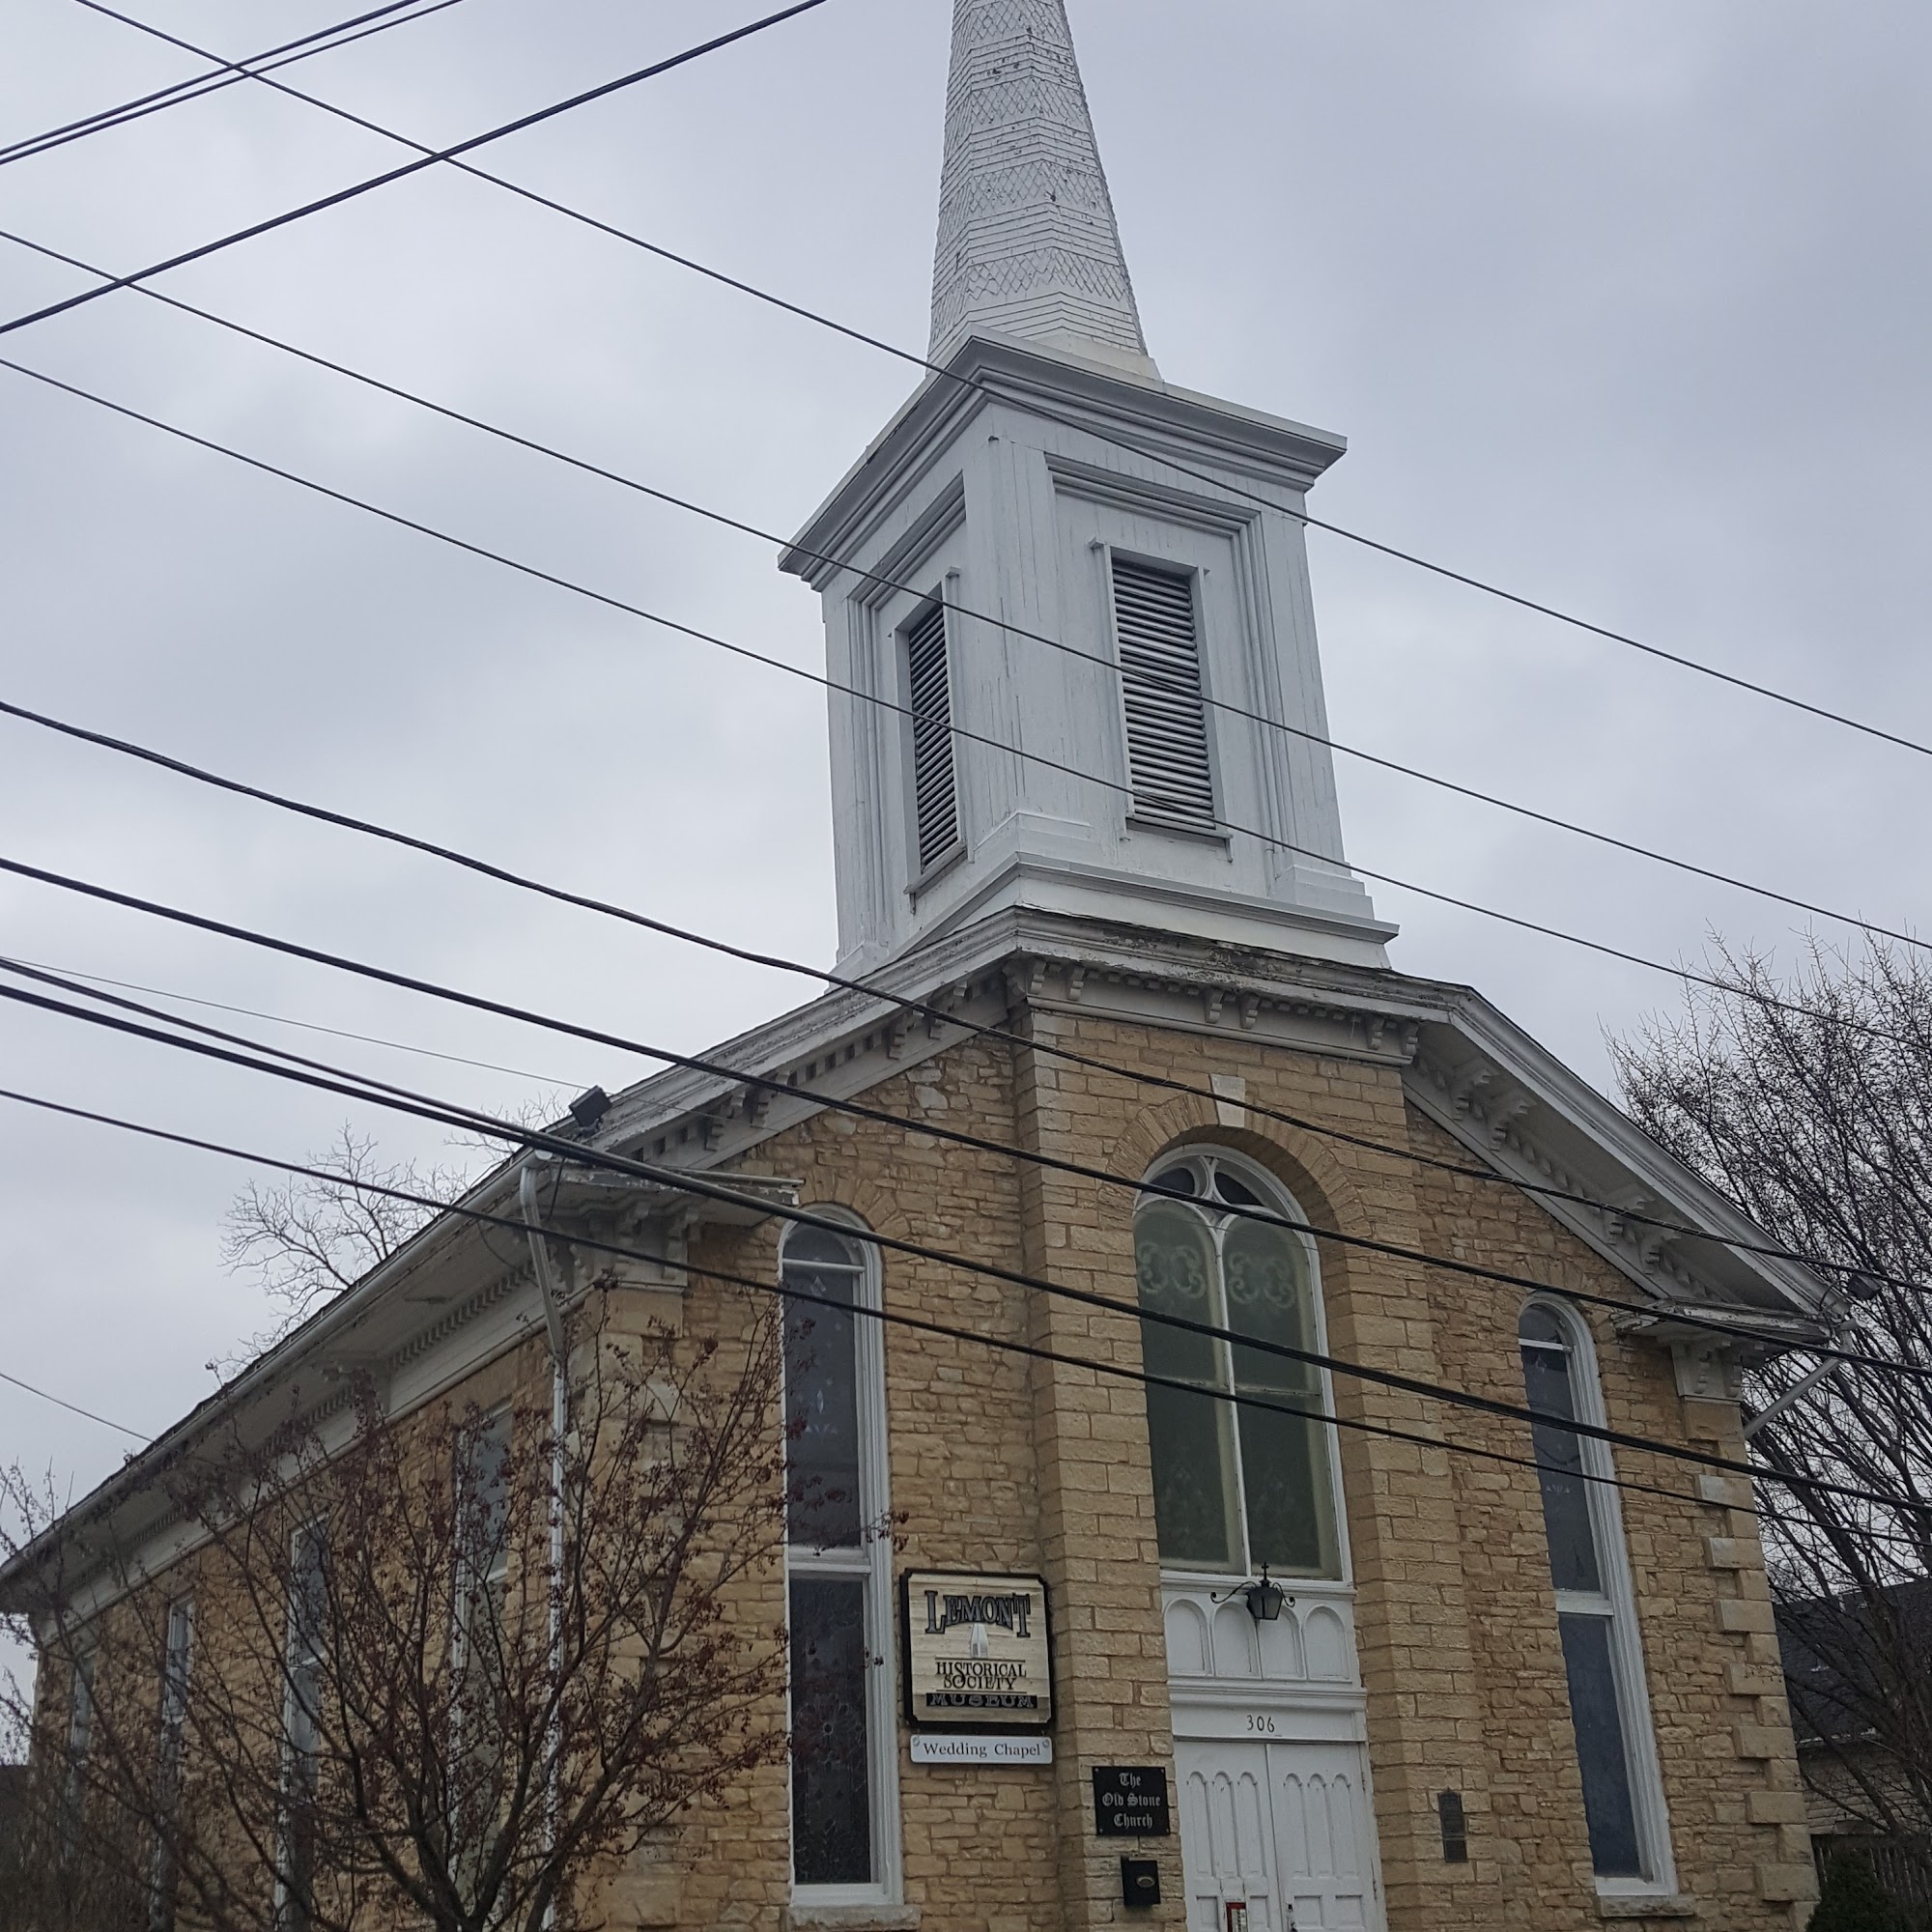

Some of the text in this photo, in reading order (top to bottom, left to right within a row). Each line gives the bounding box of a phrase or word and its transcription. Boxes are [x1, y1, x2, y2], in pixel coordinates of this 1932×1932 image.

[924, 1590, 1031, 1638] LEMONT
[935, 1662, 1027, 1678] HISTORICAL
[943, 1674, 1016, 1690] SOCIETY
[929, 1693, 1035, 1708] MUSEUM
[1246, 1714, 1275, 1733] 306
[923, 1742, 1041, 1758] Wedding Chapel
[1119, 1772, 1141, 1788] The
[1101, 1792, 1161, 1807] Old Stone
[1113, 1812, 1153, 1829] Church
